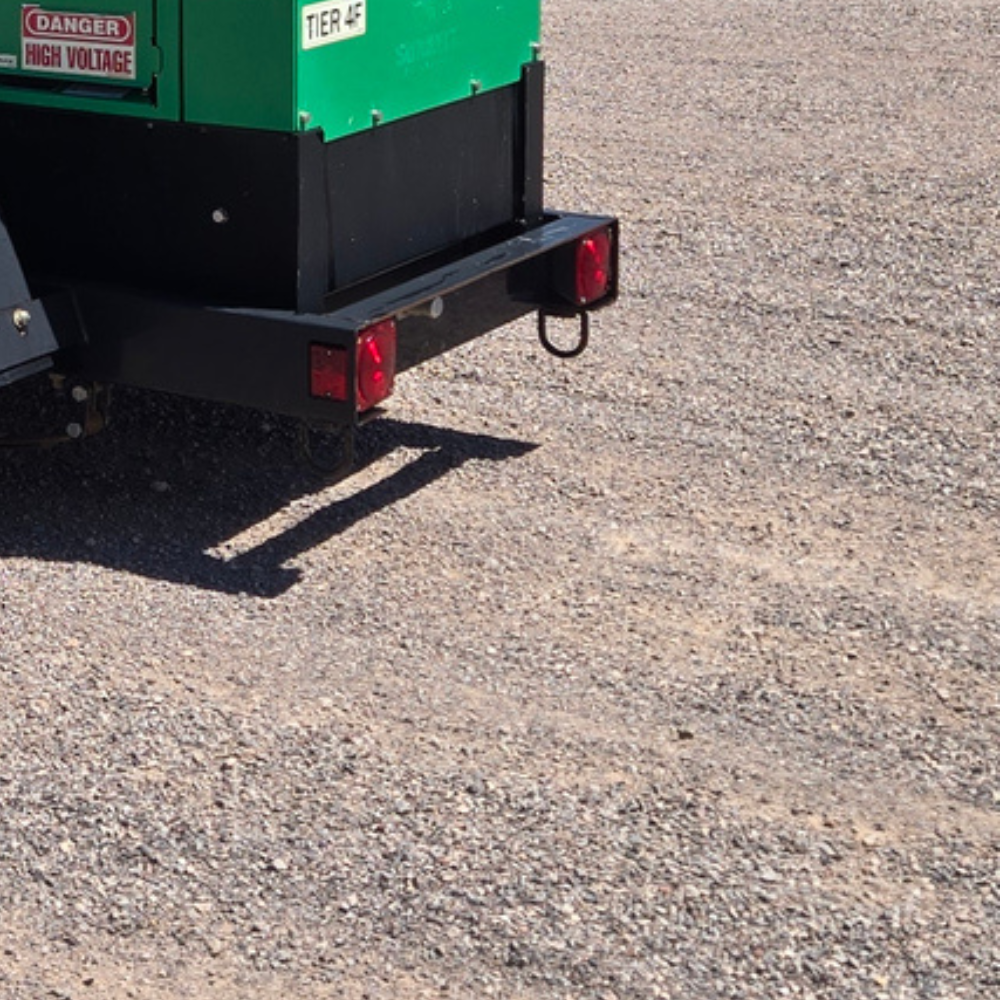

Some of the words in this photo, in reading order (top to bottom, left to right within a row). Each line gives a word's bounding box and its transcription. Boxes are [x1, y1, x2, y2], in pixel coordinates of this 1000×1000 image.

[36, 14, 120, 36] DANGER
[306, 7, 341, 40] TIER
[345, 1, 362, 28] 4F
[25, 43, 62, 67] HIGH
[66, 45, 132, 74] VOLTAGE
